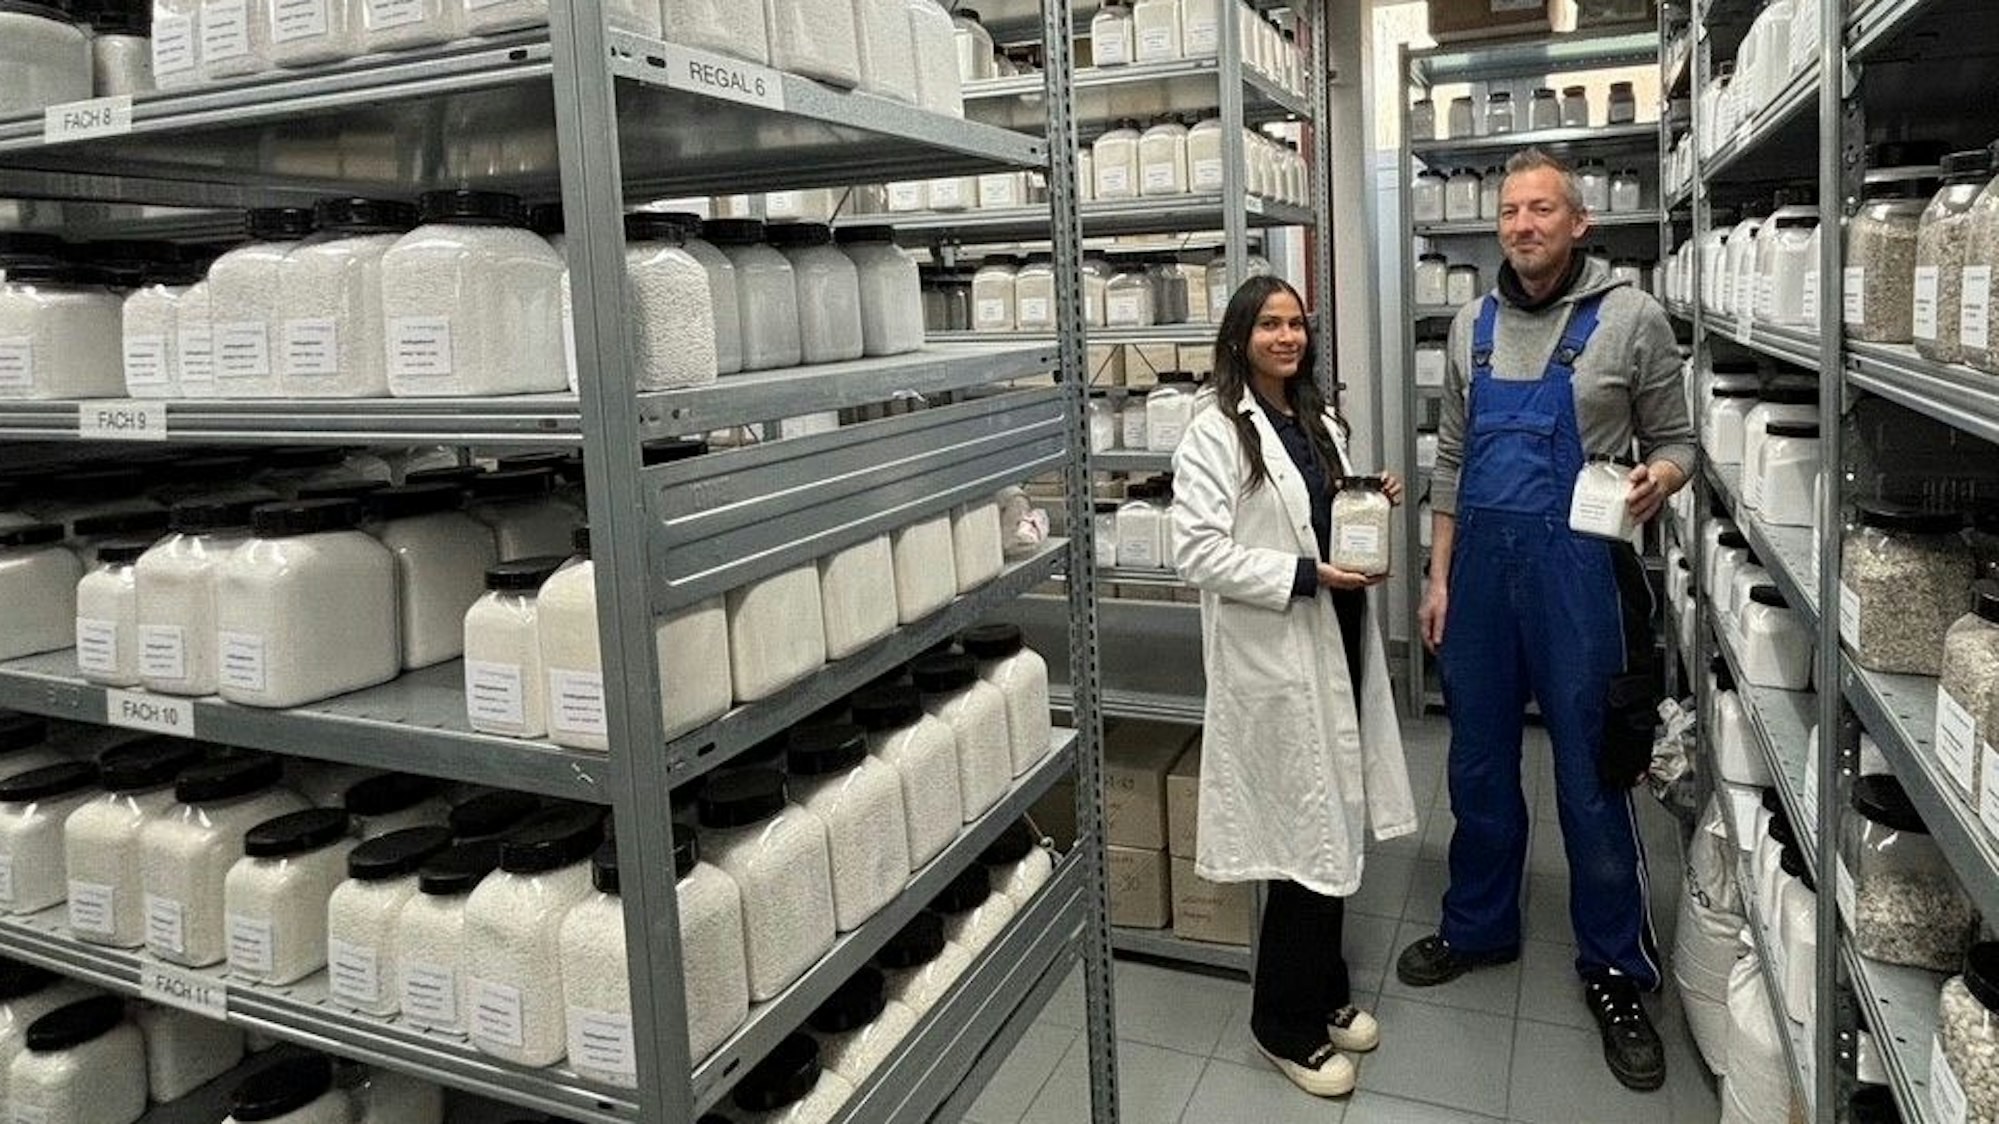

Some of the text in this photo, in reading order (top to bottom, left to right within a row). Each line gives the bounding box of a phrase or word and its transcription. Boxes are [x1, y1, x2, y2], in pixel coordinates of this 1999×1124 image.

[689, 60, 765, 97] REGAL 6
[64, 107, 111, 131] FACH 8
[98, 411, 146, 430] FACH 9
[123, 700, 178, 726] FACH 10
[157, 975, 210, 1005] FACH 11
